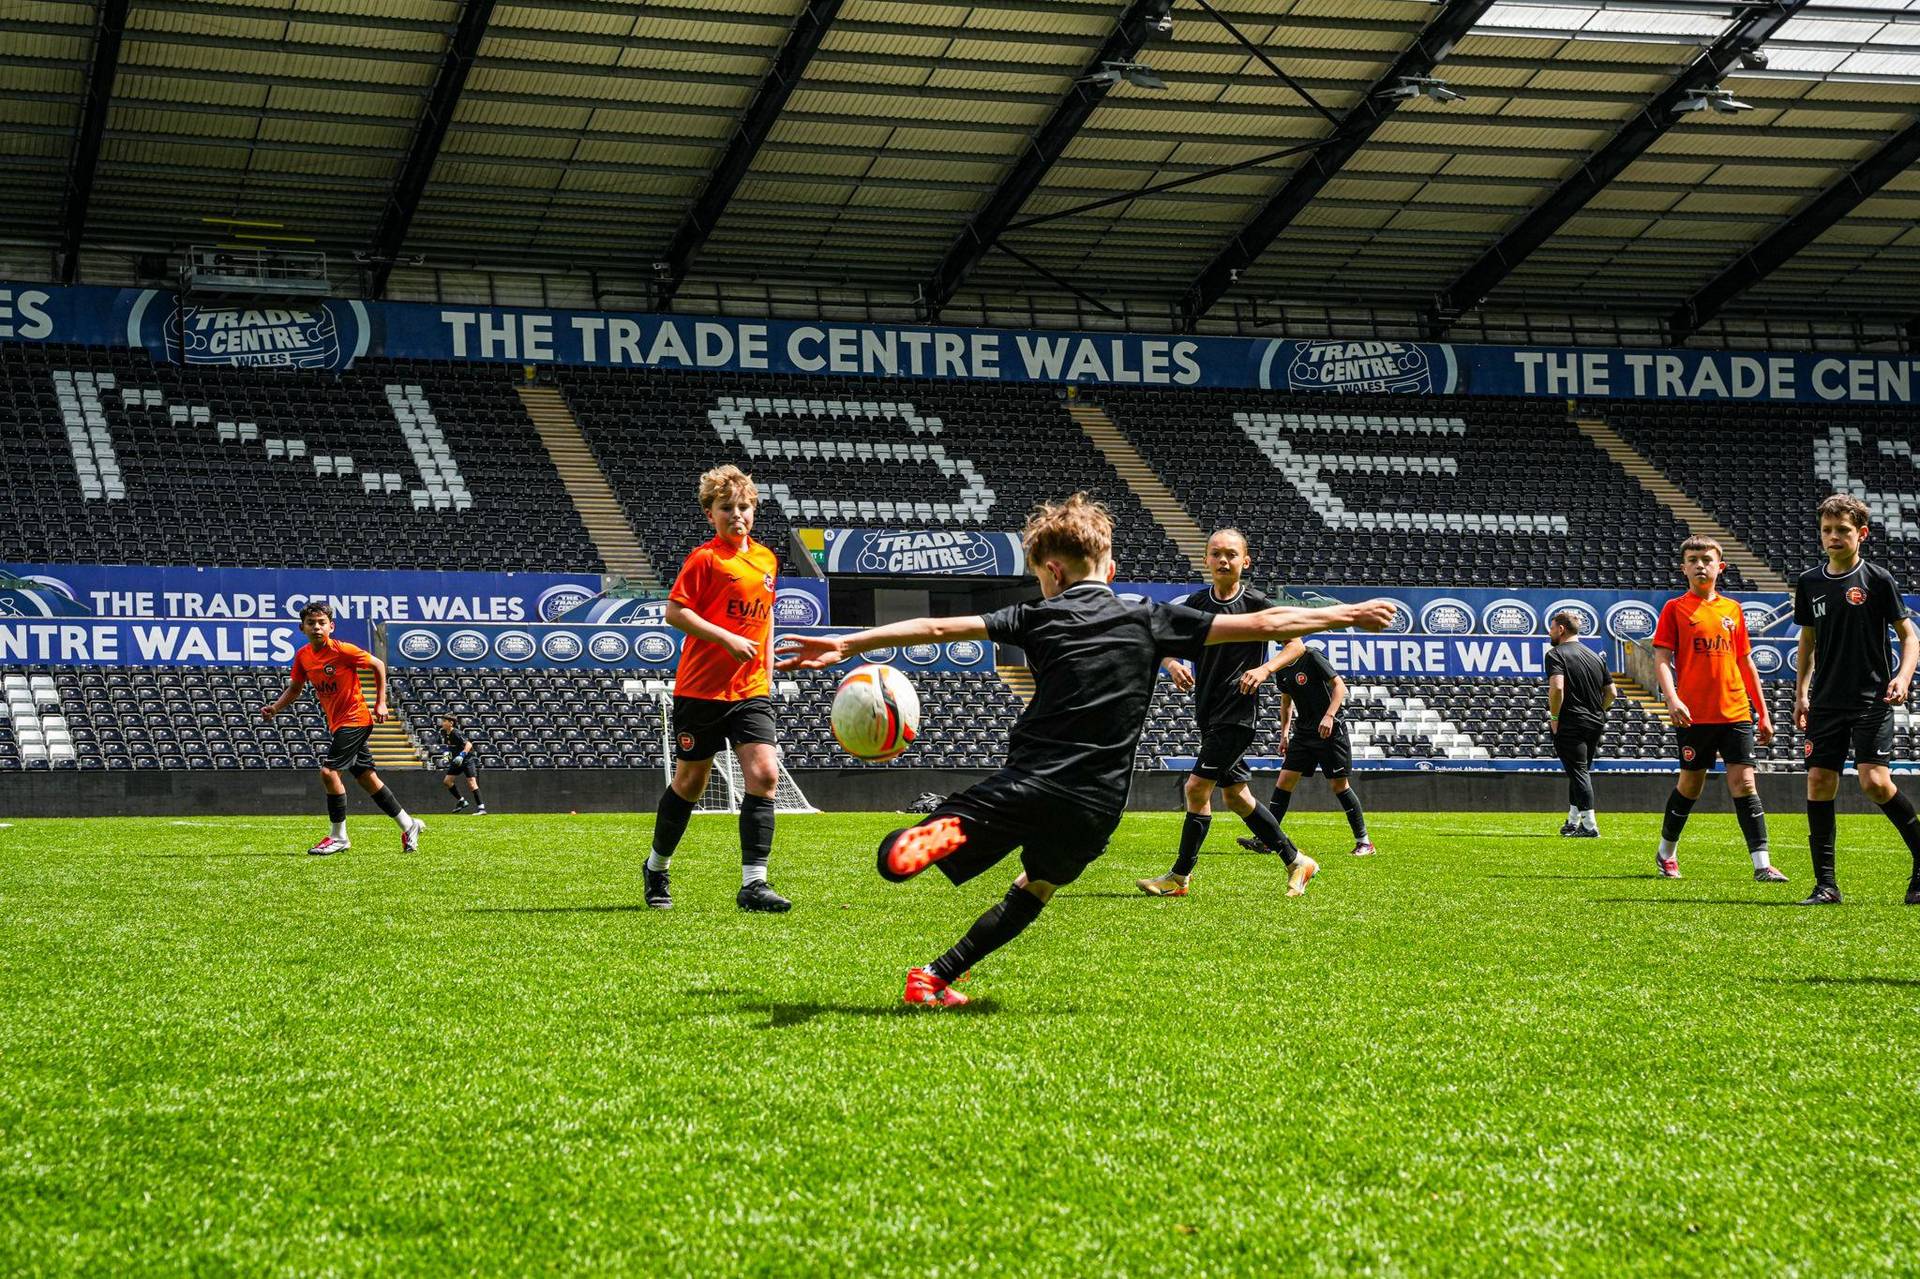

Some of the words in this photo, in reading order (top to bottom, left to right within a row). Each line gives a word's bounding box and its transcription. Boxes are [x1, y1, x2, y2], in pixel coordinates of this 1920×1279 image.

[195, 307, 315, 331] TRADE
[210, 326, 309, 354] CENTRE
[441, 311, 554, 360] THE
[571, 317, 769, 369] TRADE
[787, 326, 1000, 378] CENTRE
[1015, 335, 1201, 385] WALES
[1308, 342, 1405, 363] TRADE
[234, 354, 287, 367] WALES
[1320, 356, 1401, 383] CENTRE
[1341, 380, 1383, 393] WALES
[1514, 352, 1610, 395] THE
[1624, 354, 1796, 399] TRADE
[1811, 358, 1920, 402] CEN
[876, 531, 974, 554] TRADE
[887, 546, 968, 573] CENTRE
[90, 591, 154, 616] THE
[163, 592, 276, 618] TRADE
[417, 596, 525, 621] WALES
[1812, 602, 1827, 619] LN
[132, 626, 295, 662] WALES
